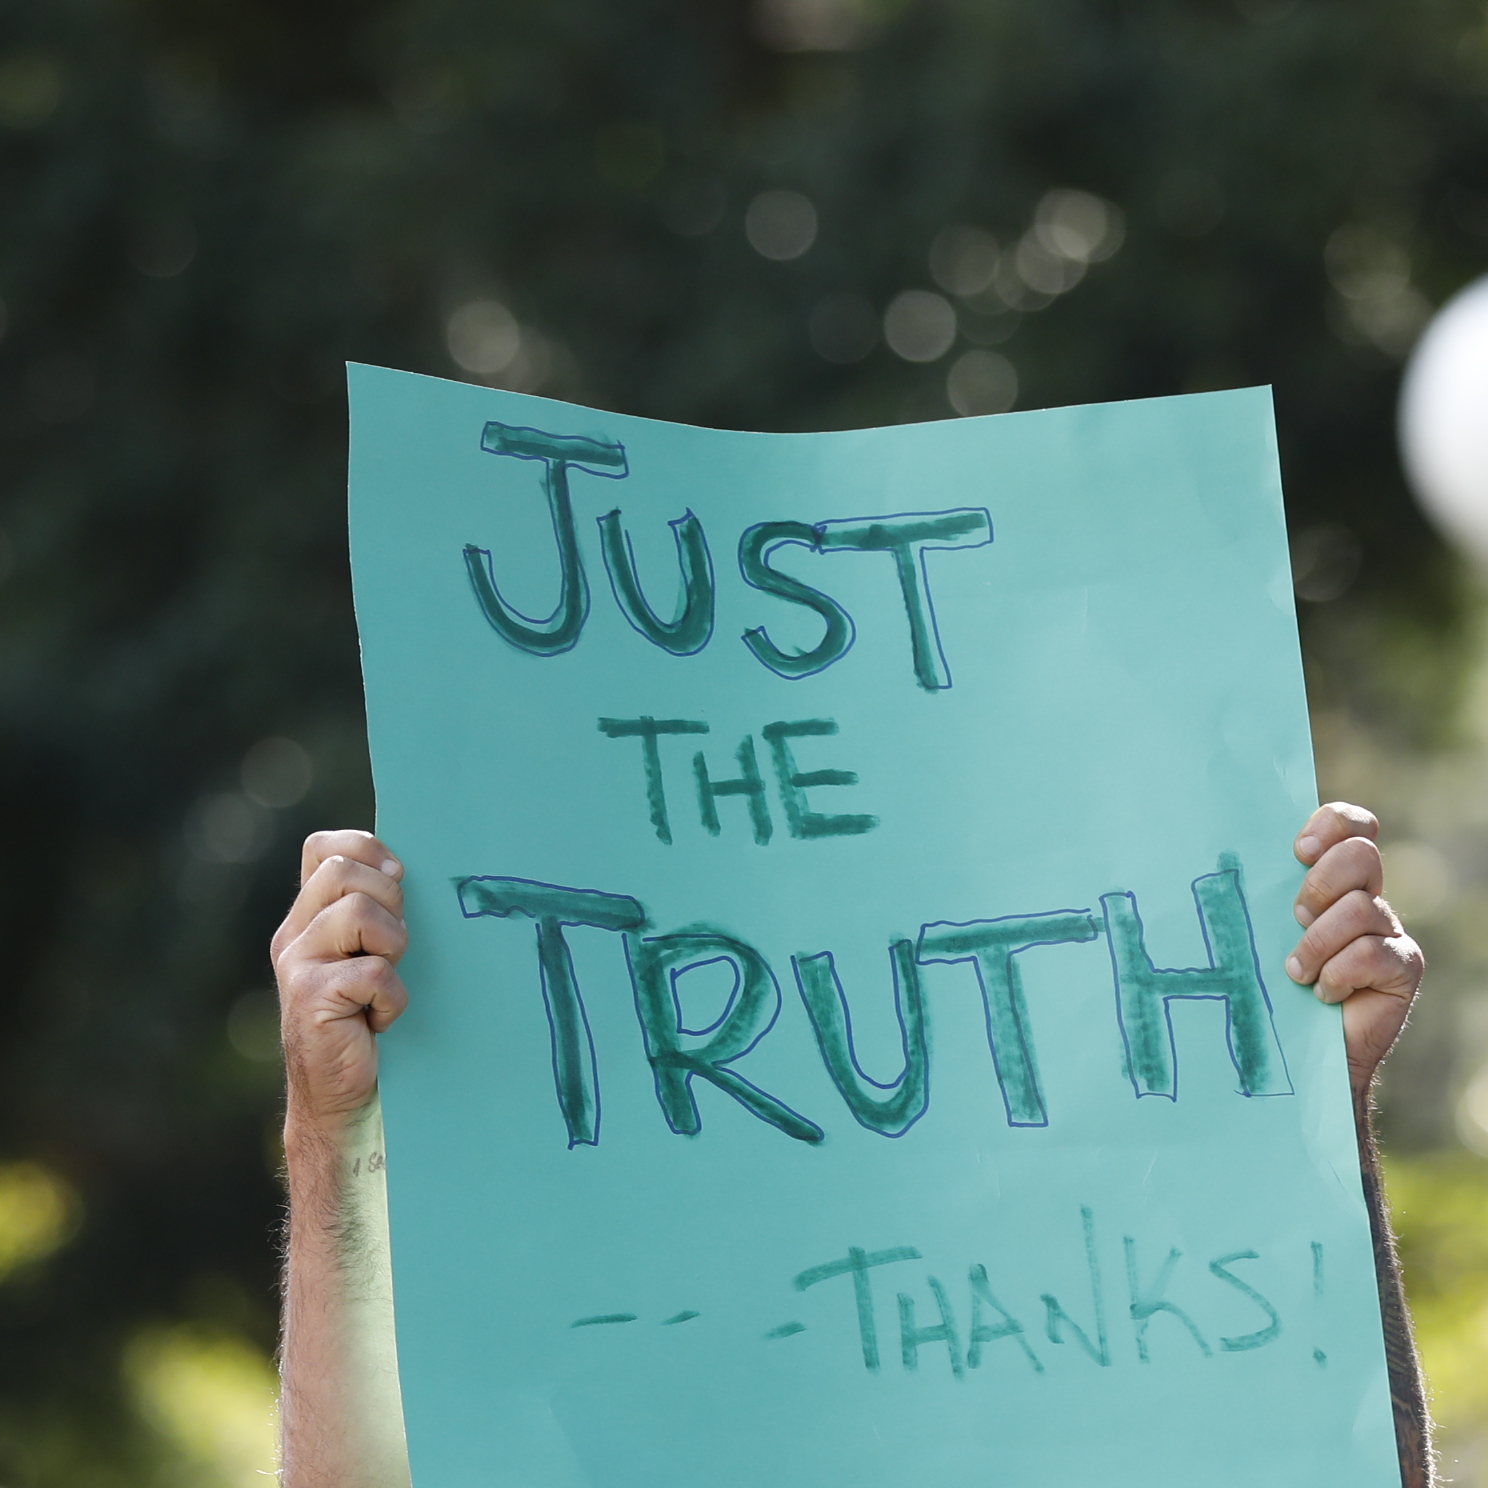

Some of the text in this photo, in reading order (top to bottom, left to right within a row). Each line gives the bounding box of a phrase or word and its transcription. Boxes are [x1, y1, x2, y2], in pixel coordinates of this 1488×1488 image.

[463, 420, 994, 695] JUST
[597, 716, 880, 846] THE
[449, 851, 1295, 1150] TRUTH
